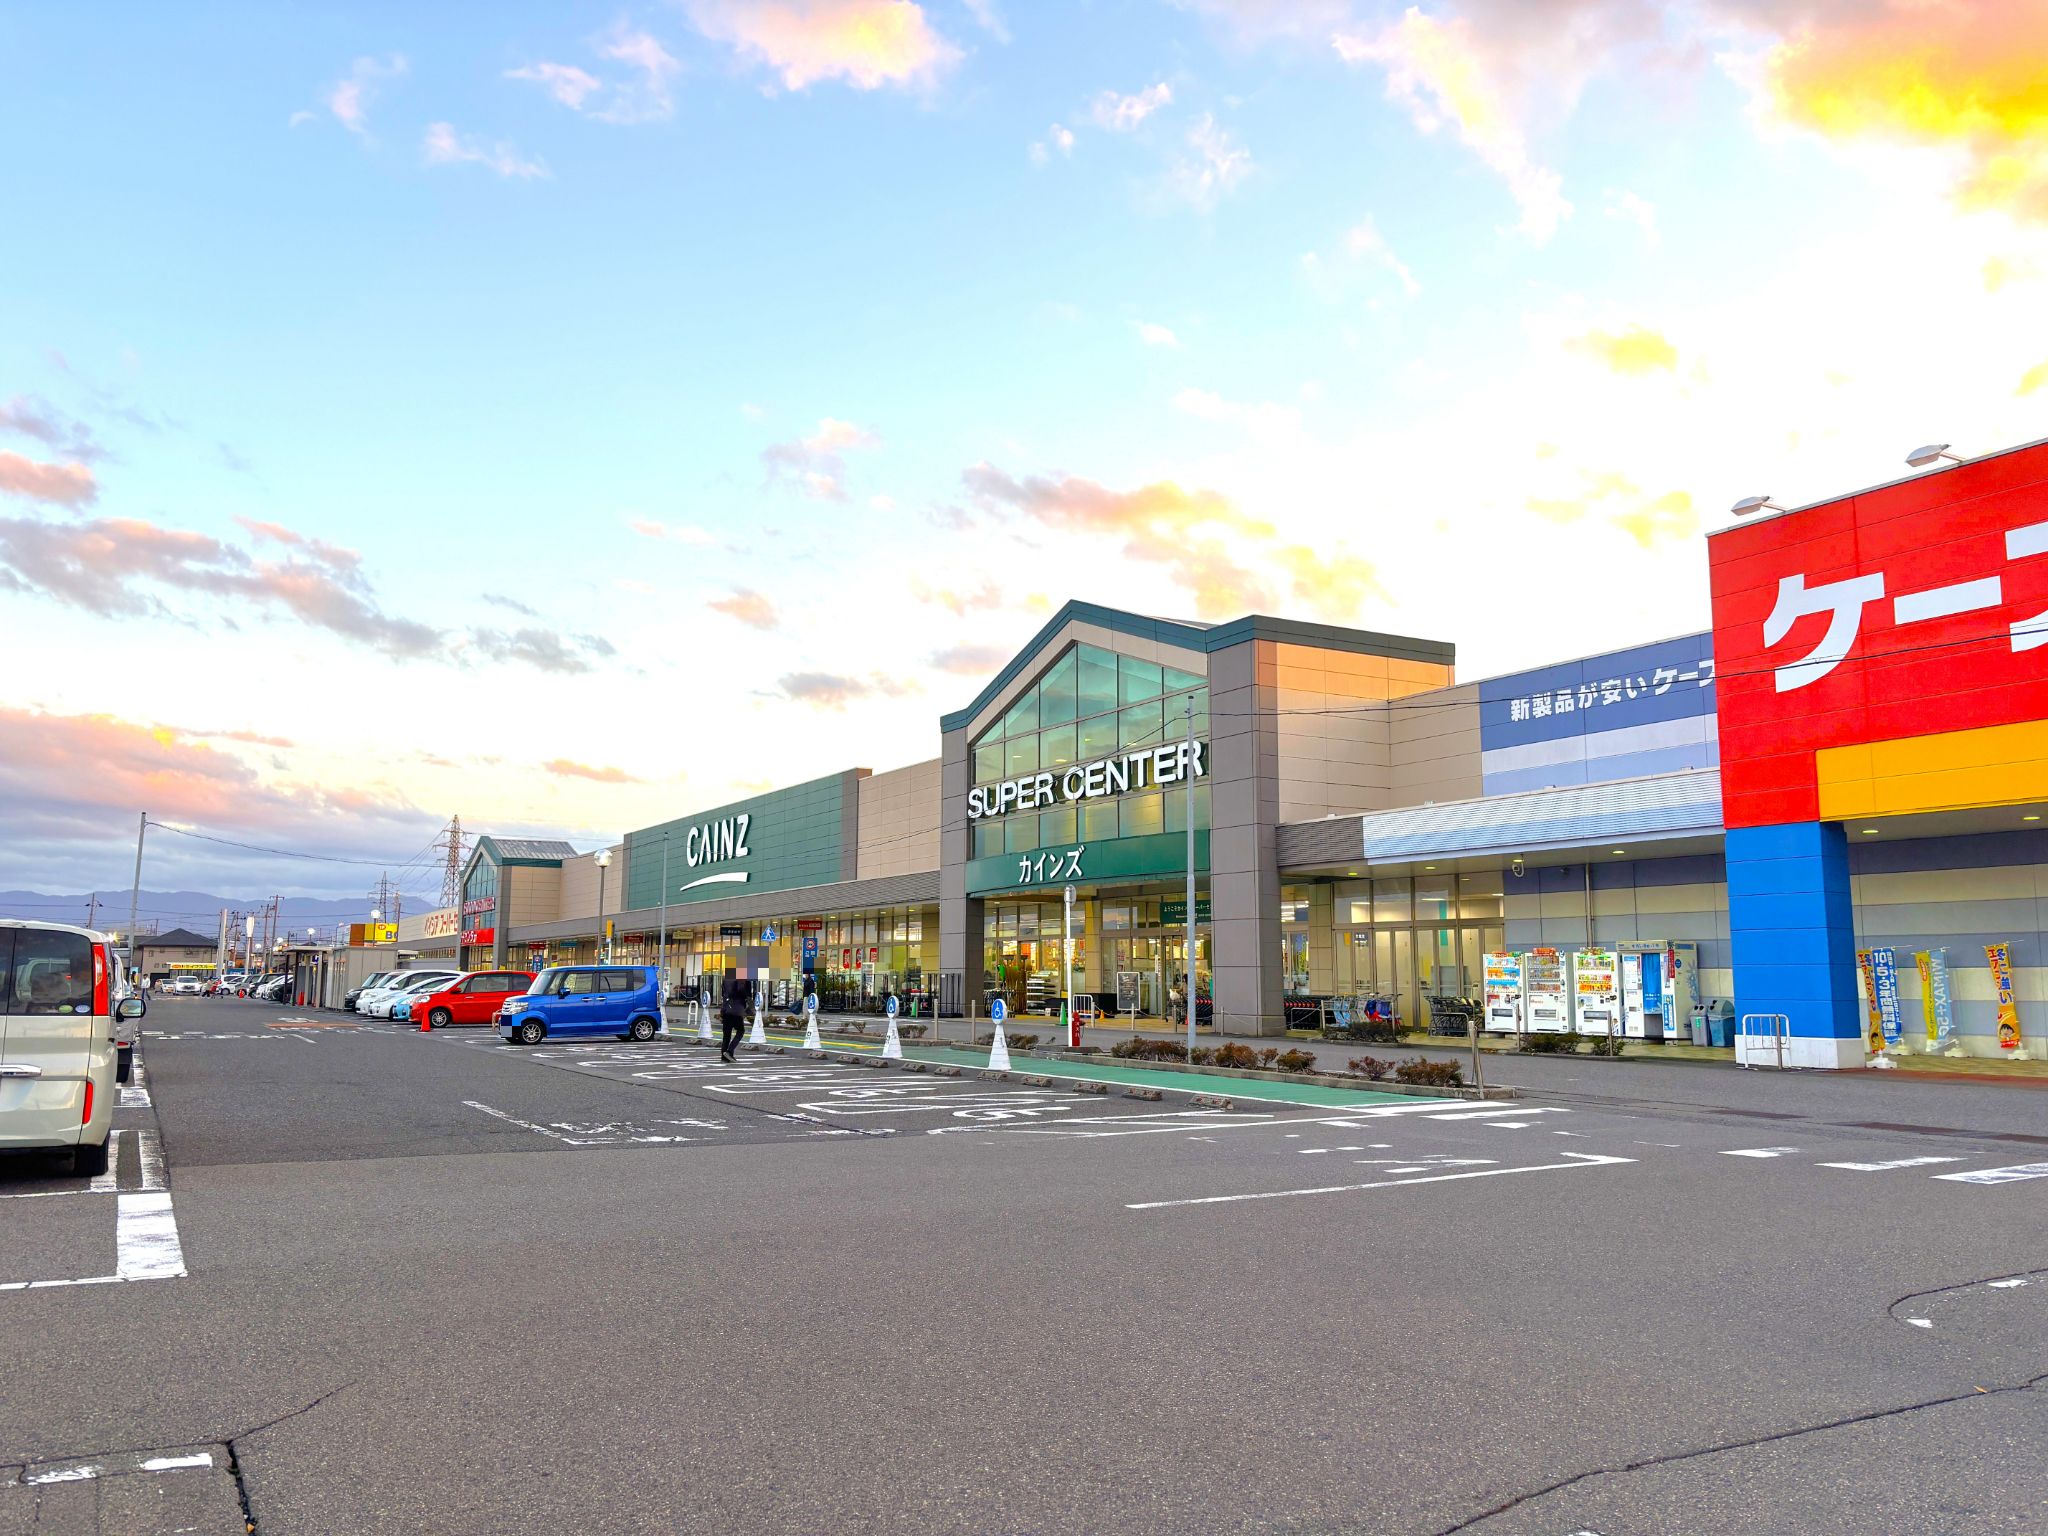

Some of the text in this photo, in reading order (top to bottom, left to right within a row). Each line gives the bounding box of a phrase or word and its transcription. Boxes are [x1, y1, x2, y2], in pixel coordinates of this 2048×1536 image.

[968, 741, 1204, 819] SUPER CENTER
[687, 815, 749, 867] CAINZ
[1018, 844, 1085, 884] カインズ
